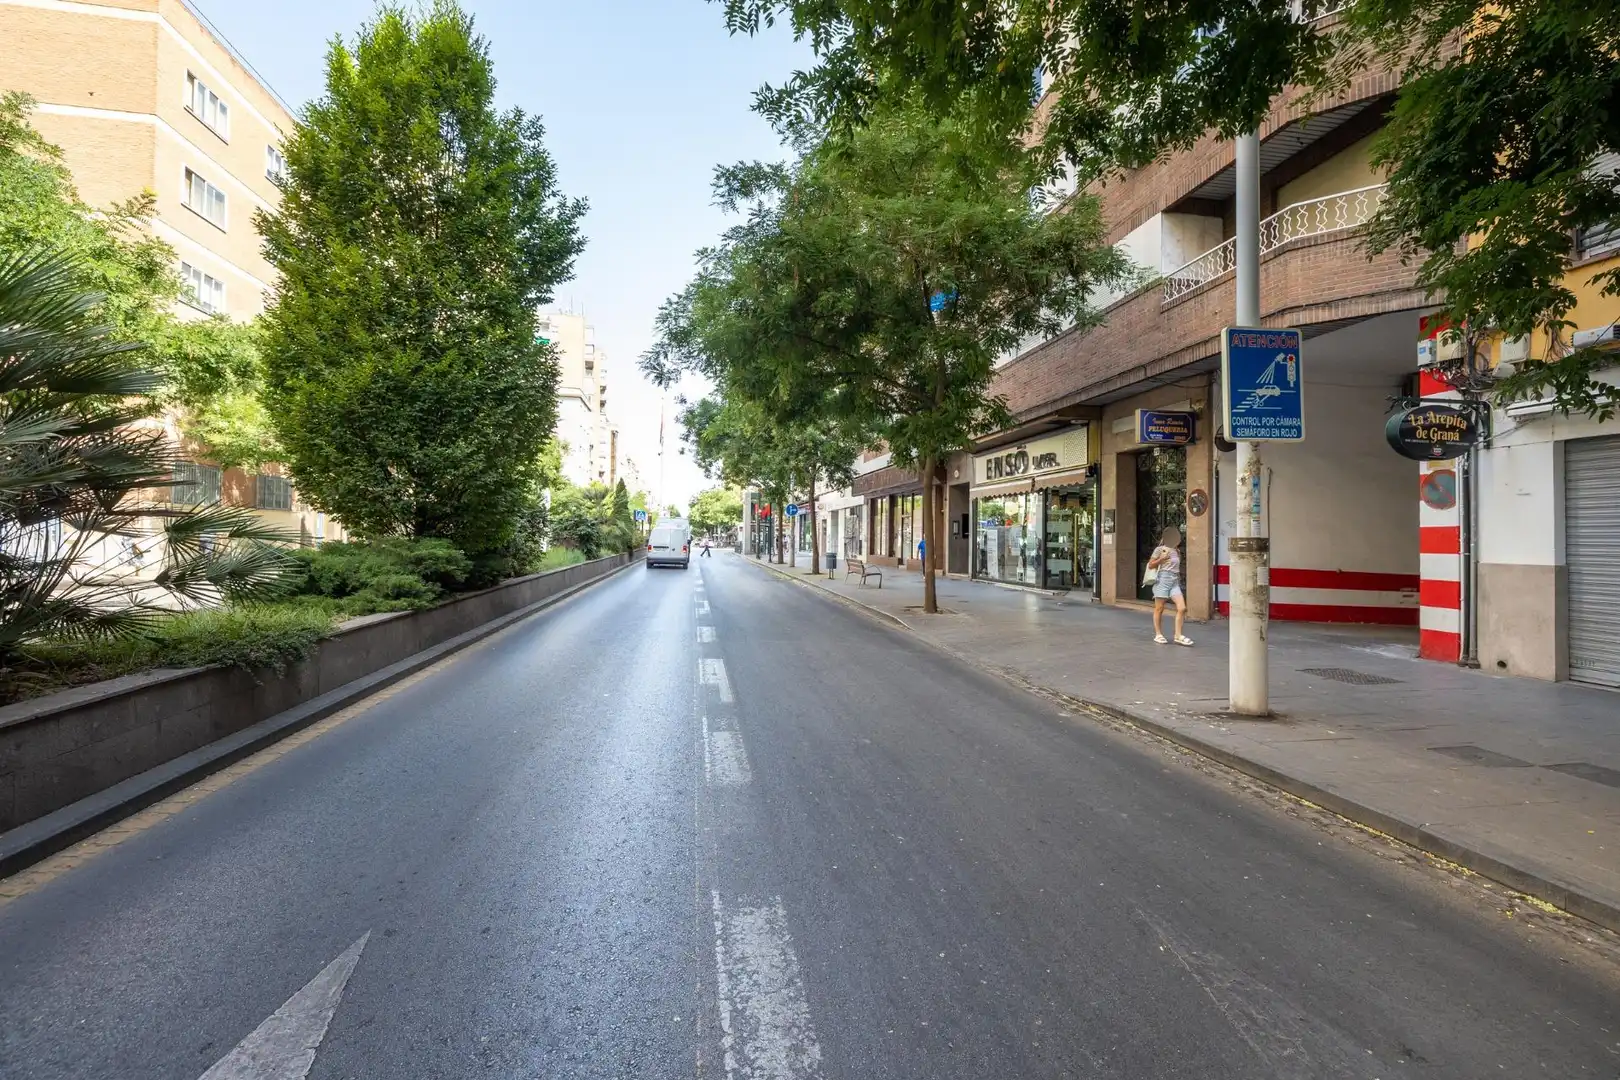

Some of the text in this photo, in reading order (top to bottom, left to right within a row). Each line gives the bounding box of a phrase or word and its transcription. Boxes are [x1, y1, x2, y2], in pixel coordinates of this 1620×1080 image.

[1232, 333, 1298, 348] ATENCIÓN
[1232, 415, 1301, 426] CONTROL POR CÁMARA
[1408, 411, 1467, 430] La Arepita
[1236, 426, 1297, 437] SEMÁFORO EN ROJO
[1416, 426, 1460, 443] de Graná
